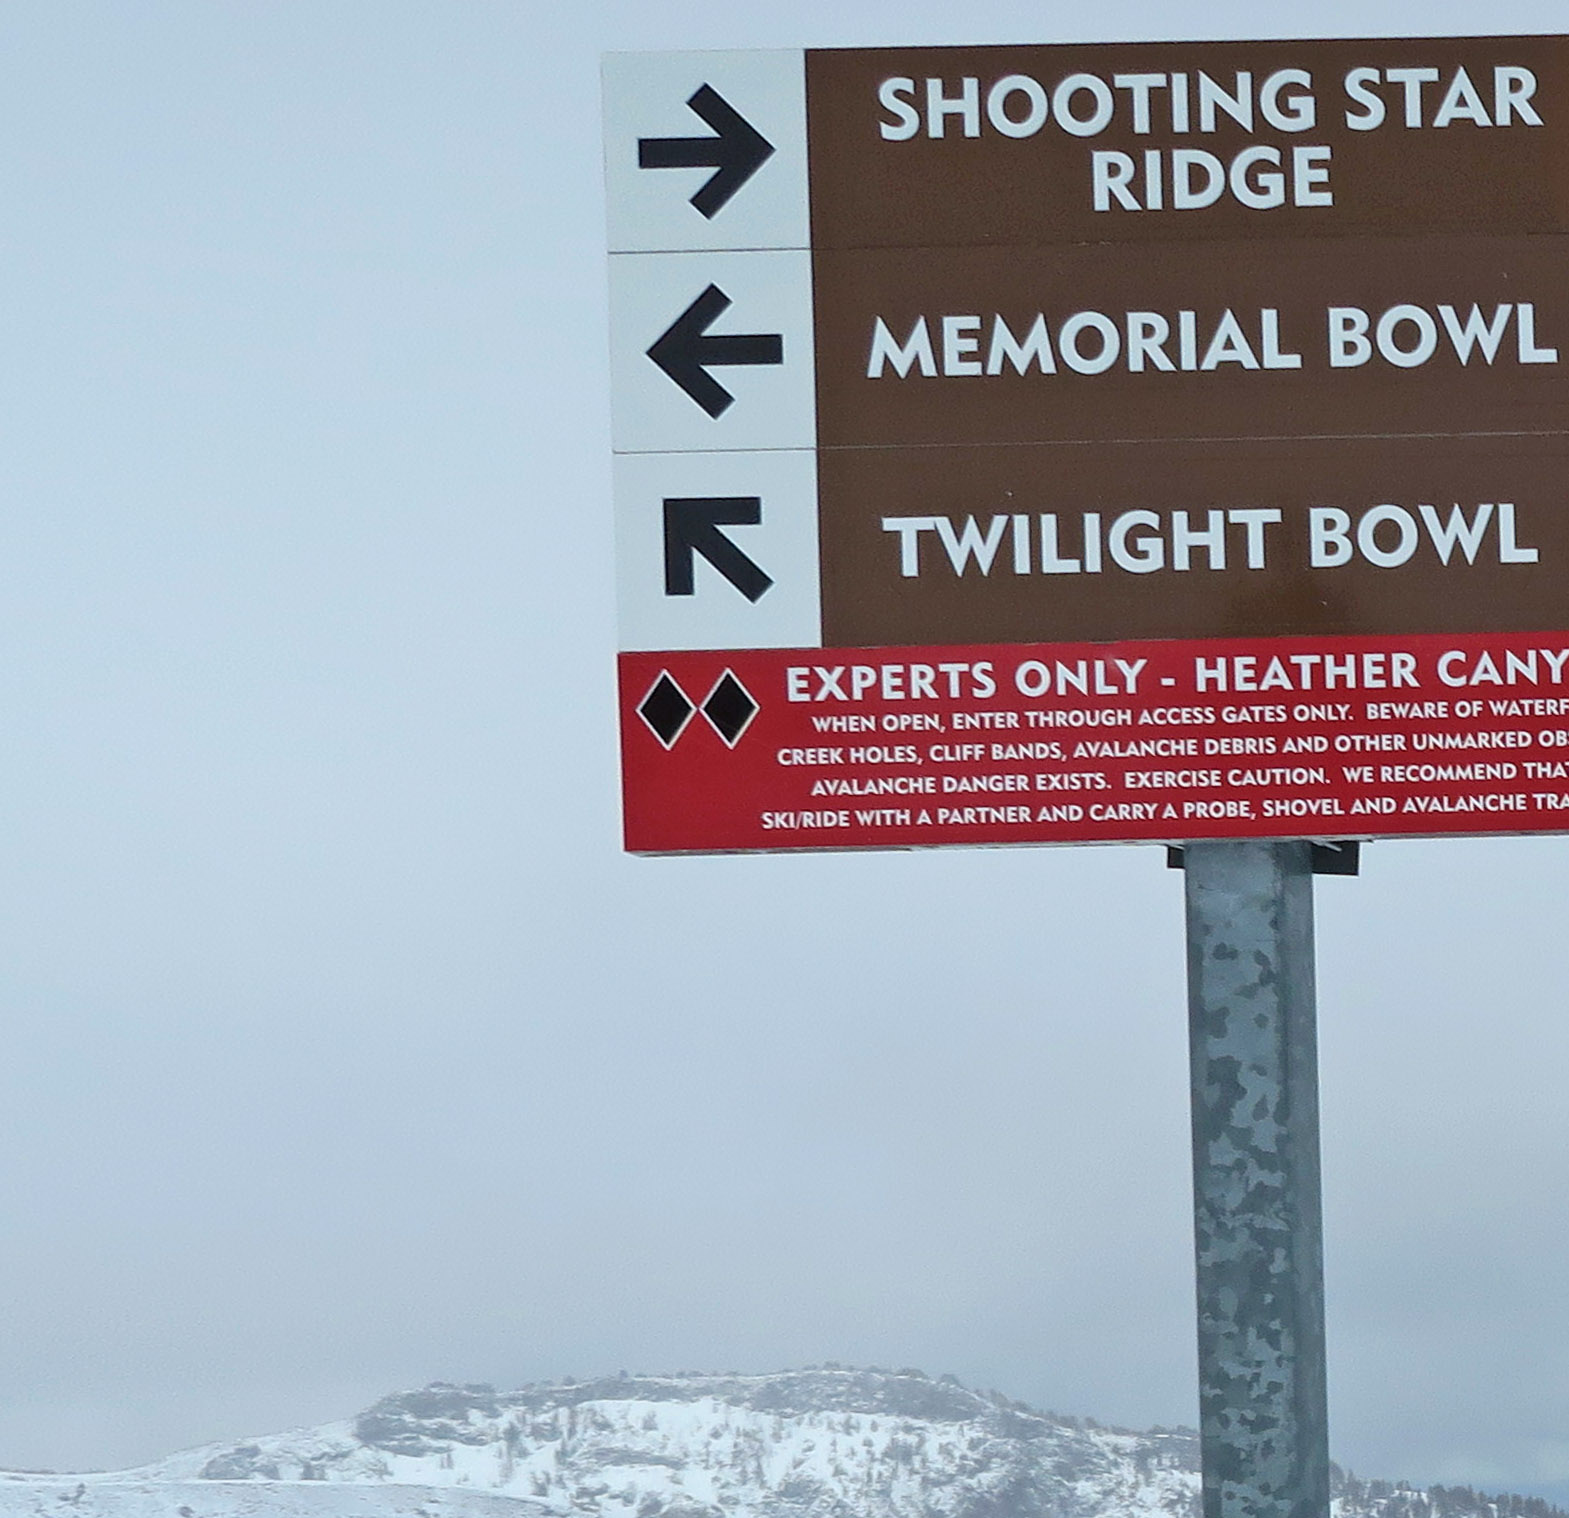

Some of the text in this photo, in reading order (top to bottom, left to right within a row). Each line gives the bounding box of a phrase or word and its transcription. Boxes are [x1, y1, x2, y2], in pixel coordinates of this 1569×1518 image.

[878, 65, 1544, 141] SHOOTING STAR
[1092, 145, 1333, 211] RIDGE
[867, 302, 1558, 379] MEMORIAL BOWL
[881, 502, 1539, 580] TWILIGHT BOWL
[786, 661, 996, 702] EXPERTS
[1015, 658, 1148, 698] ONLY
[1195, 652, 1421, 692] HEATHER
[811, 715, 876, 733] WHEN
[882, 713, 946, 733] OPEN,
[952, 711, 1020, 730] ENTER
[1024, 708, 1132, 728] THROUGH
[1138, 706, 1216, 725] ACCESS
[1221, 704, 1287, 724] GATES
[1293, 703, 1354, 723] ONLY.
[1366, 701, 1449, 720] BEWARE
[1454, 700, 1484, 718] OF
[777, 747, 844, 766] CREEK
[849, 745, 923, 765] HOLES,
[929, 744, 985, 762] CLIFF
[991, 741, 1067, 762] BANDS,
[1073, 739, 1198, 758] AVALANCHE
[1204, 736, 1277, 755] DEBRIS
[1282, 735, 1329, 753] AND
[1334, 734, 1407, 752] OTHER
[1412, 731, 1532, 751] UNMARKED
[811, 776, 937, 796] AVALANCHE
[942, 774, 1030, 793] DANGER
[1035, 772, 1112, 791] EXISTS.
[1124, 769, 1222, 789] EXERCISE
[1227, 767, 1331, 787] CAUTION.
[1342, 766, 1374, 783] WE
[1380, 762, 1517, 783] RECOMMEND
[761, 810, 850, 831] SKI/RIDE
[854, 809, 911, 826] WITH
[916, 809, 933, 825] A
[937, 806, 1032, 825] PARTNER
[1036, 804, 1084, 822] AND
[1089, 802, 1159, 821] CARRY
[1162, 803, 1179, 819] A
[1183, 800, 1256, 820] PROBE,
[1262, 798, 1345, 817] SHOVEL
[1349, 797, 1397, 815] AND
[1402, 793, 1527, 813] AVALANCHE
